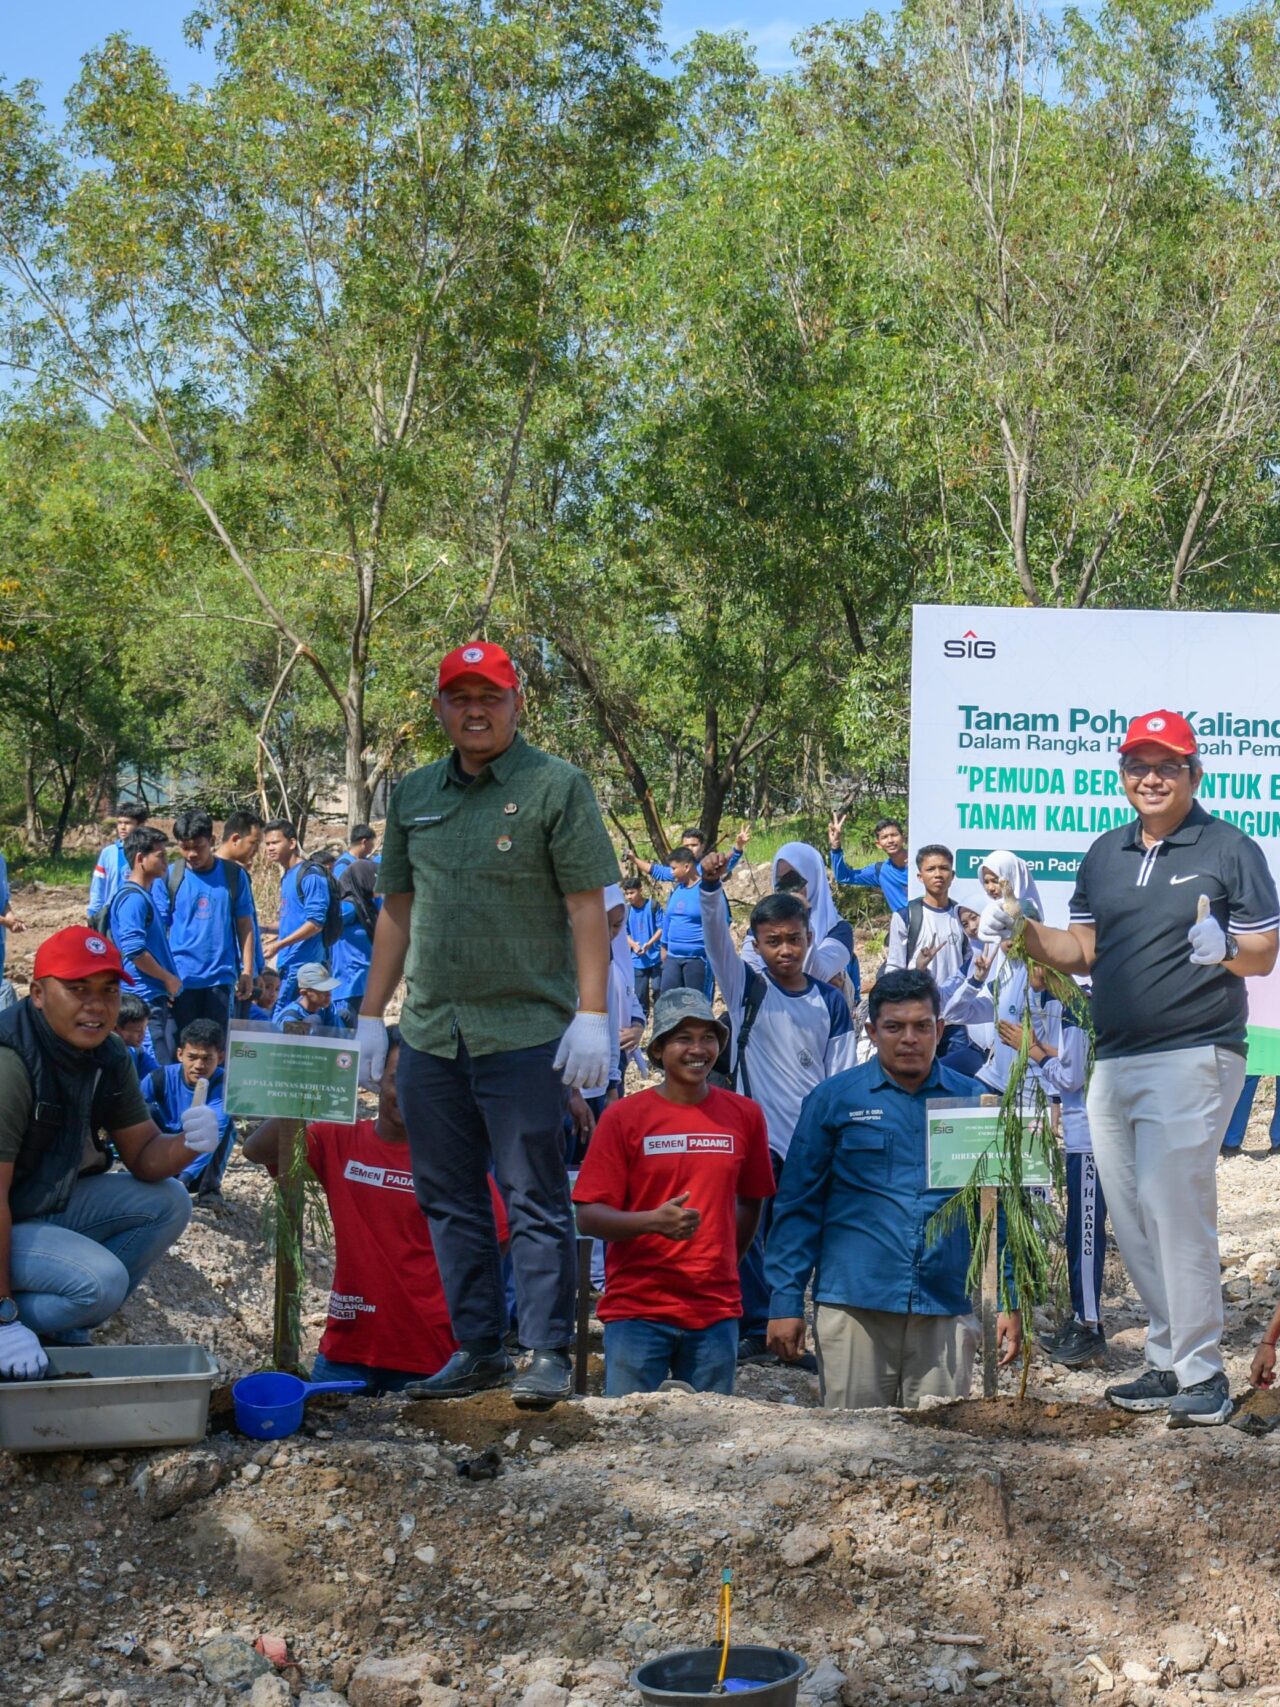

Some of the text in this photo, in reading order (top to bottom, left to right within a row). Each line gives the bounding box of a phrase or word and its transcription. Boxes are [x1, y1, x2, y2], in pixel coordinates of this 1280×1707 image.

[944, 640, 996, 659] SIG
[958, 705, 1059, 733] Tanam
[1070, 708, 1138, 735] Poh
[958, 733, 1021, 750] Dalam
[1027, 735, 1101, 755] Rangka
[1198, 739, 1232, 757] pah
[957, 765, 1065, 794] "PEMUDA
[1195, 773, 1262, 800] NTUK
[956, 803, 1036, 831] TANAM
[1045, 805, 1138, 833] KALIAN
[1048, 858, 1082, 872] Pad
[235, 1049, 257, 1059] SIG
[933, 1125, 954, 1134] SIG
[649, 1138, 729, 1150] SEMEN PADANG
[951, 1152, 994, 1161] DIREKR
[349, 1166, 416, 1188] SEMEN PADA
[1084, 1187, 1094, 1199] 14
[1083, 1205, 1094, 1256] PADANG
